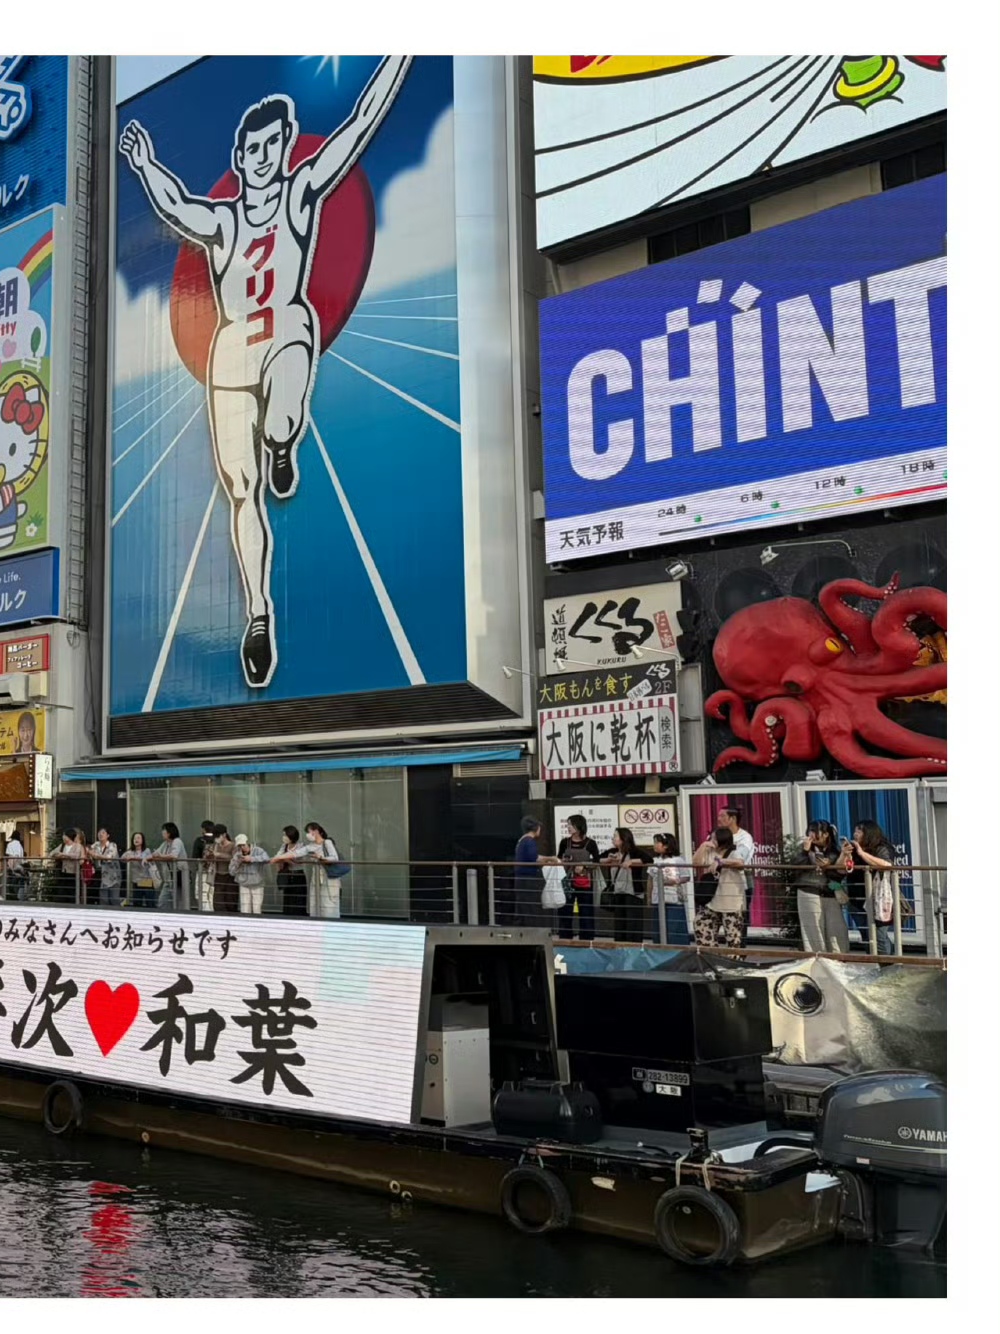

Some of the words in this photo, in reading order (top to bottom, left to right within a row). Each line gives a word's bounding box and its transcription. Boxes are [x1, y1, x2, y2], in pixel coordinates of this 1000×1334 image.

[242, 224, 278, 346] グリコ
[900, 459, 936, 475] 18時
[559, 521, 624, 550] 天気予報
[3, 571, 21, 583] Life.
[568, 597, 654, 655] くくる
[596, 656, 627, 666] KUKURU
[539, 673, 633, 703] 大阪もんを食す
[654, 680, 672, 695] 2F
[546, 711, 657, 767] 大阪に乾杯
[660, 717, 672, 749] 検索
